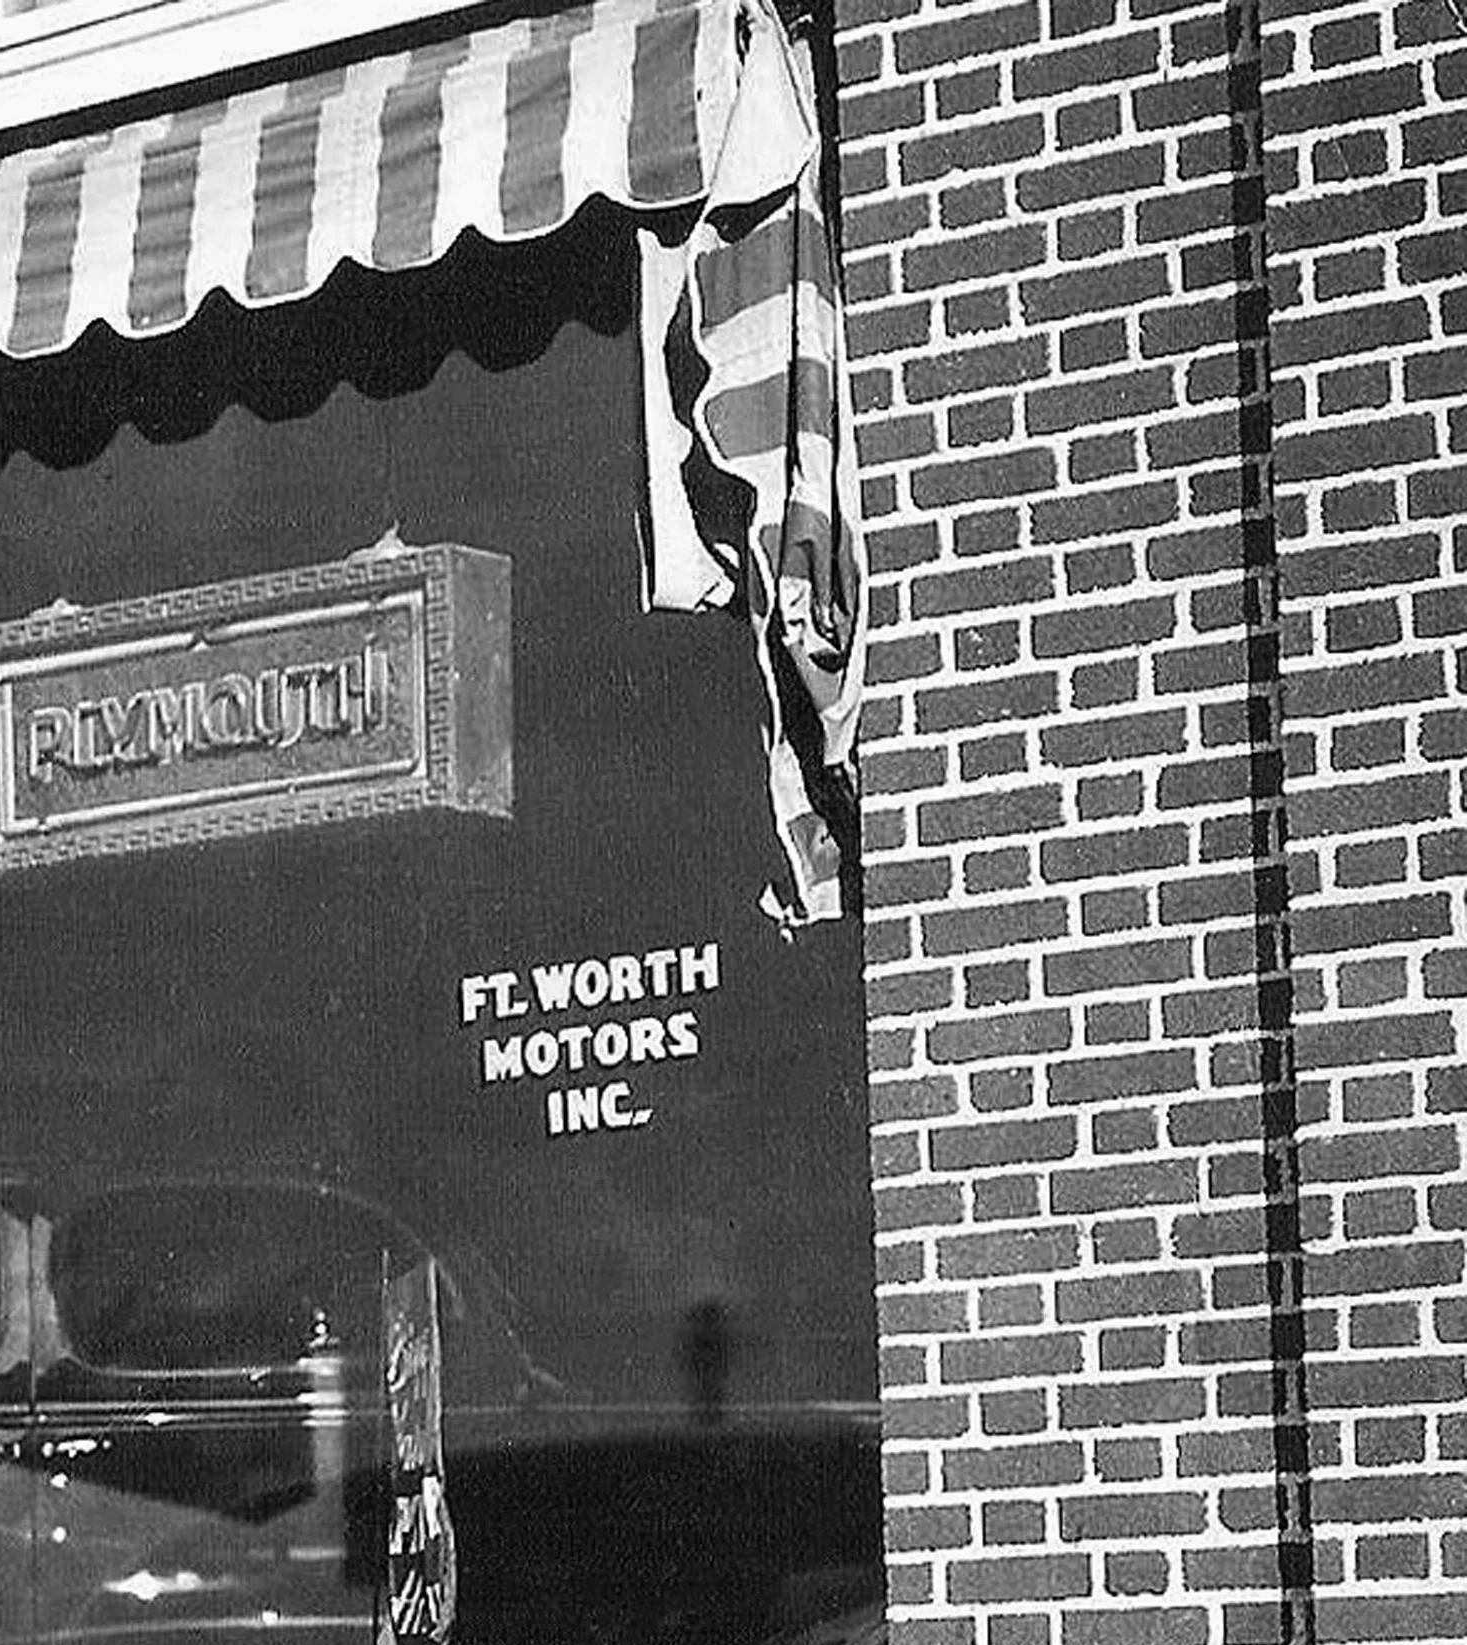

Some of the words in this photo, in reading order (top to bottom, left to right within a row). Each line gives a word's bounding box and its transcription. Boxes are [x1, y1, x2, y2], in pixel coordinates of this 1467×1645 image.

[27, 636, 392, 781] PLYMOUTH
[483, 1012, 700, 1082] MOTORS
[546, 1083, 654, 1134] INC.
